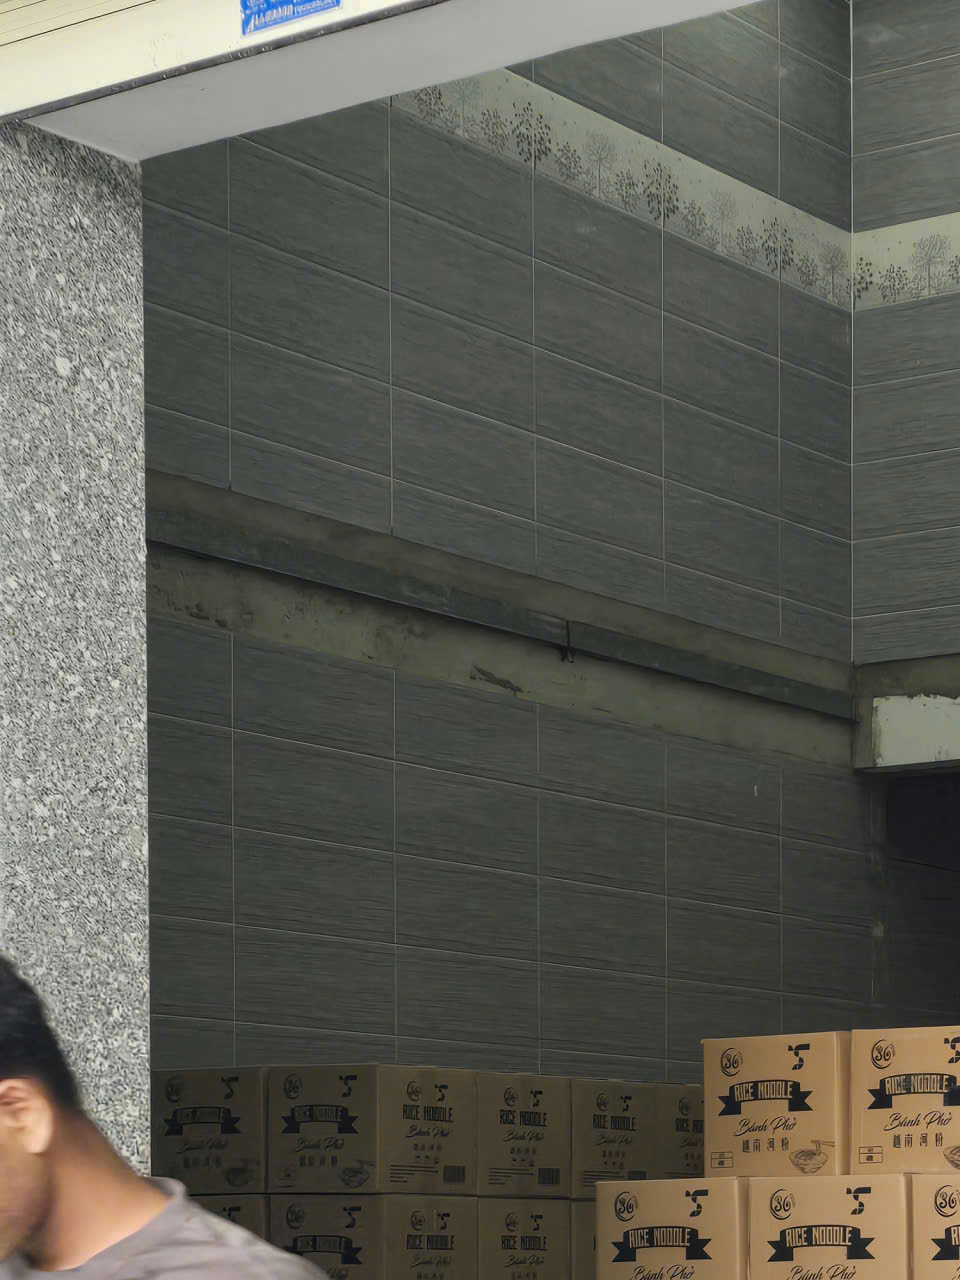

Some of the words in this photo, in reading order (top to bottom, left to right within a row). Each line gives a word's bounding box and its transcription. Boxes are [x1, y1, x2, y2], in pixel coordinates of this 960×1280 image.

[724, 1053, 739, 1069] 36
[875, 1046, 892, 1062] 36
[734, 1083, 754, 1102] RICE
[758, 1081, 793, 1100] NOODLE
[885, 1076, 906, 1095] RICE
[910, 1075, 948, 1093] NOODLE
[618, 1198, 634, 1214] 36
[774, 1196, 791, 1212] 36
[939, 1192, 956, 1208] 36
[628, 1228, 649, 1248] RICE
[654, 1228, 690, 1246] NOODLE
[786, 1228, 807, 1248] RICE
[812, 1226, 852, 1246] NOODLE
